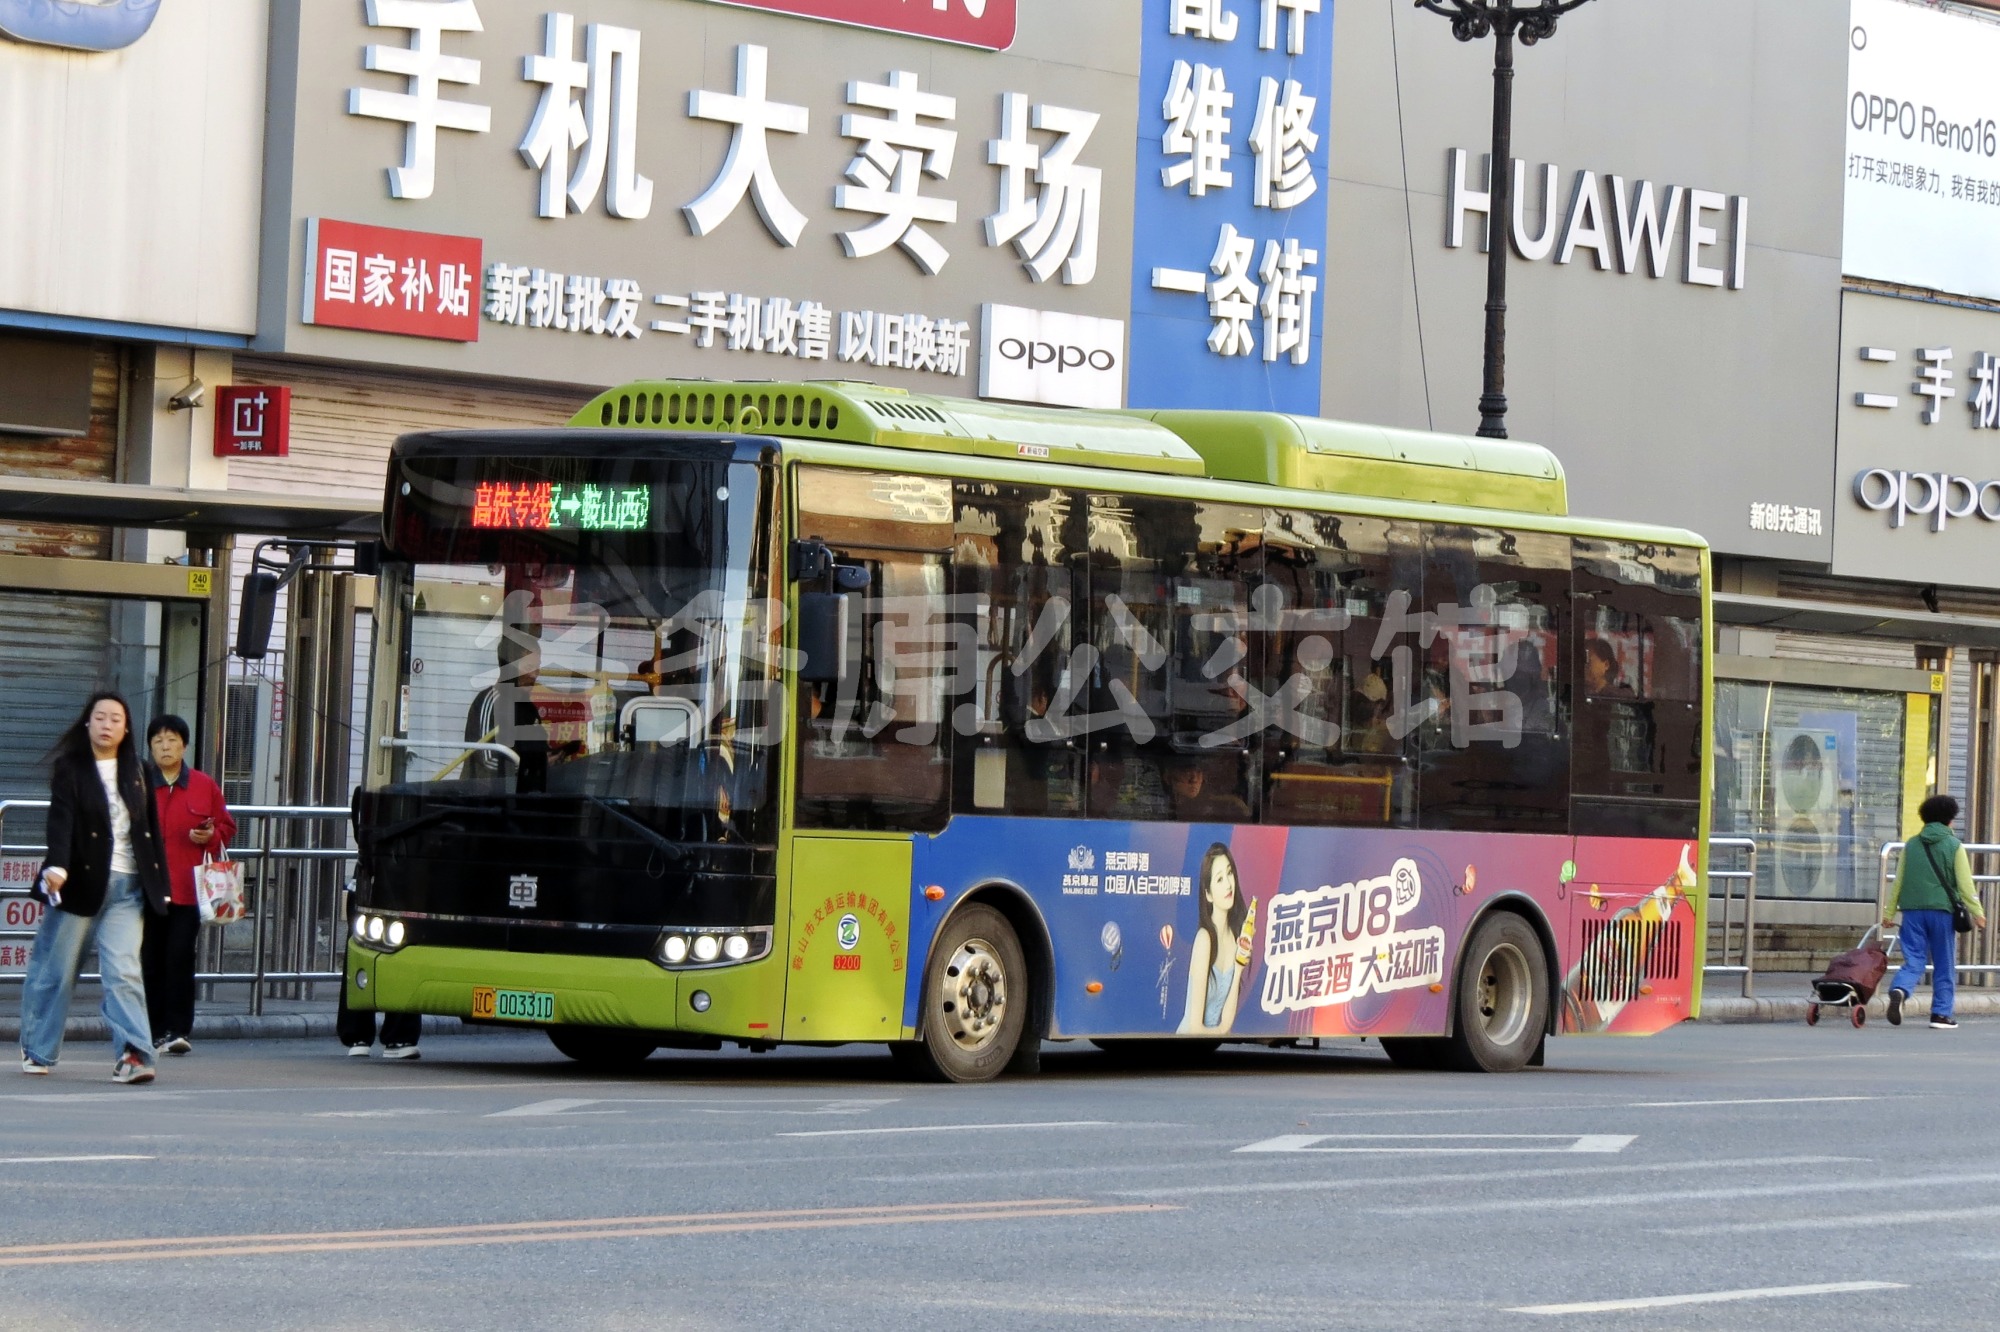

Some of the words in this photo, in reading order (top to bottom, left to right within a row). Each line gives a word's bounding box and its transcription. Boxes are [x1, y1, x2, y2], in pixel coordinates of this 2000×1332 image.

[349, 0, 1103, 285] 手机大卖场
[1161, 59, 1319, 210] 维修
[1851, 91, 1916, 140] OPPO
[1921, 105, 1997, 158] Reno16
[1446, 147, 1748, 290] HUAWEI
[325, 247, 472, 317] 国家补贴
[1152, 223, 1319, 365] 一条街
[484, 262, 644, 340] 新机批发
[651, 290, 833, 361] 二手机收售
[837, 309, 972, 377] 以旧换新
[232, 441, 262, 451] 一加手机
[1749, 501, 1823, 536] 新创先通讯
[192, 573, 208, 585] 240
[1062, 874, 1099, 887] 燕京啤酒
[1104, 851, 1150, 872] 燕京啤酒
[1104, 874, 1192, 896] 中国人自己的啤酒
[1270, 885, 1393, 956] 燕京U8
[834, 955, 860, 970] 3200
